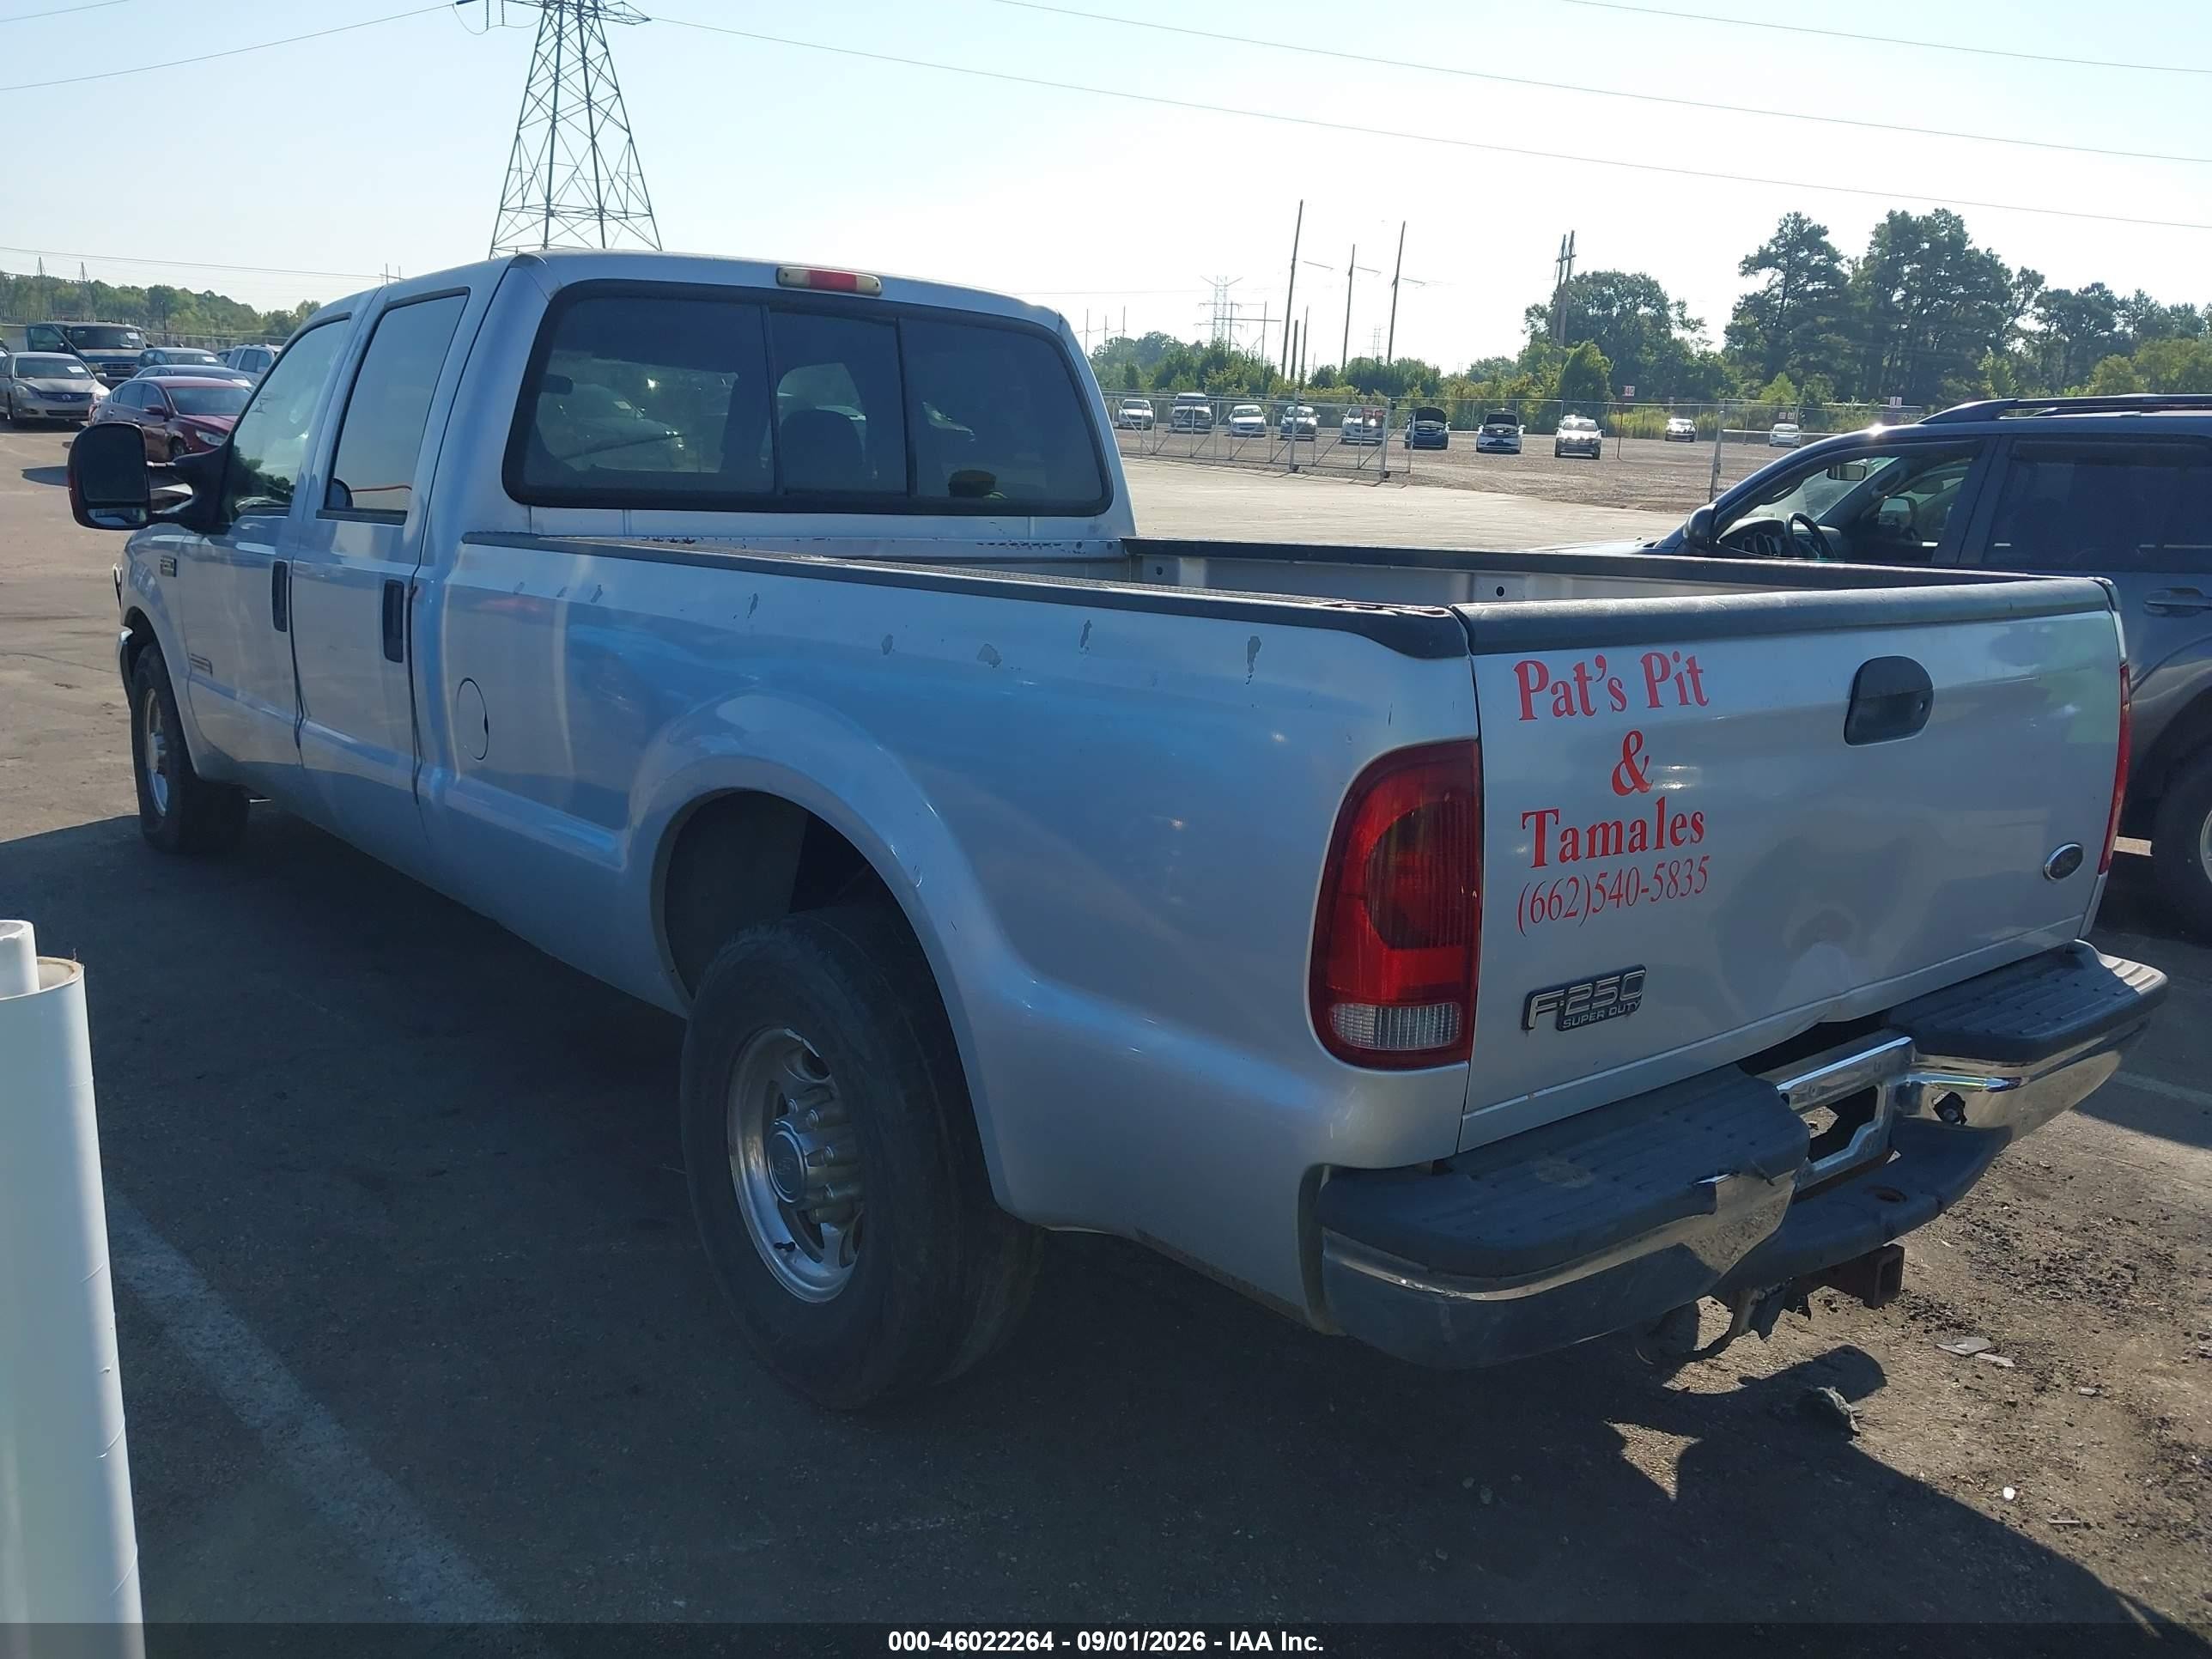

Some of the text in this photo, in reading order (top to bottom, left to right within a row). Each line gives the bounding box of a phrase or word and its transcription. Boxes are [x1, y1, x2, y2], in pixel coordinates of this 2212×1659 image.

[1514, 650, 1711, 721] Pat's Pit
[1611, 729, 1653, 796] &
[1522, 796, 1705, 869] Tamales
[1516, 855, 1711, 936] (662)540-5835
[1562, 1000, 1642, 1028] SUPER DUTY
